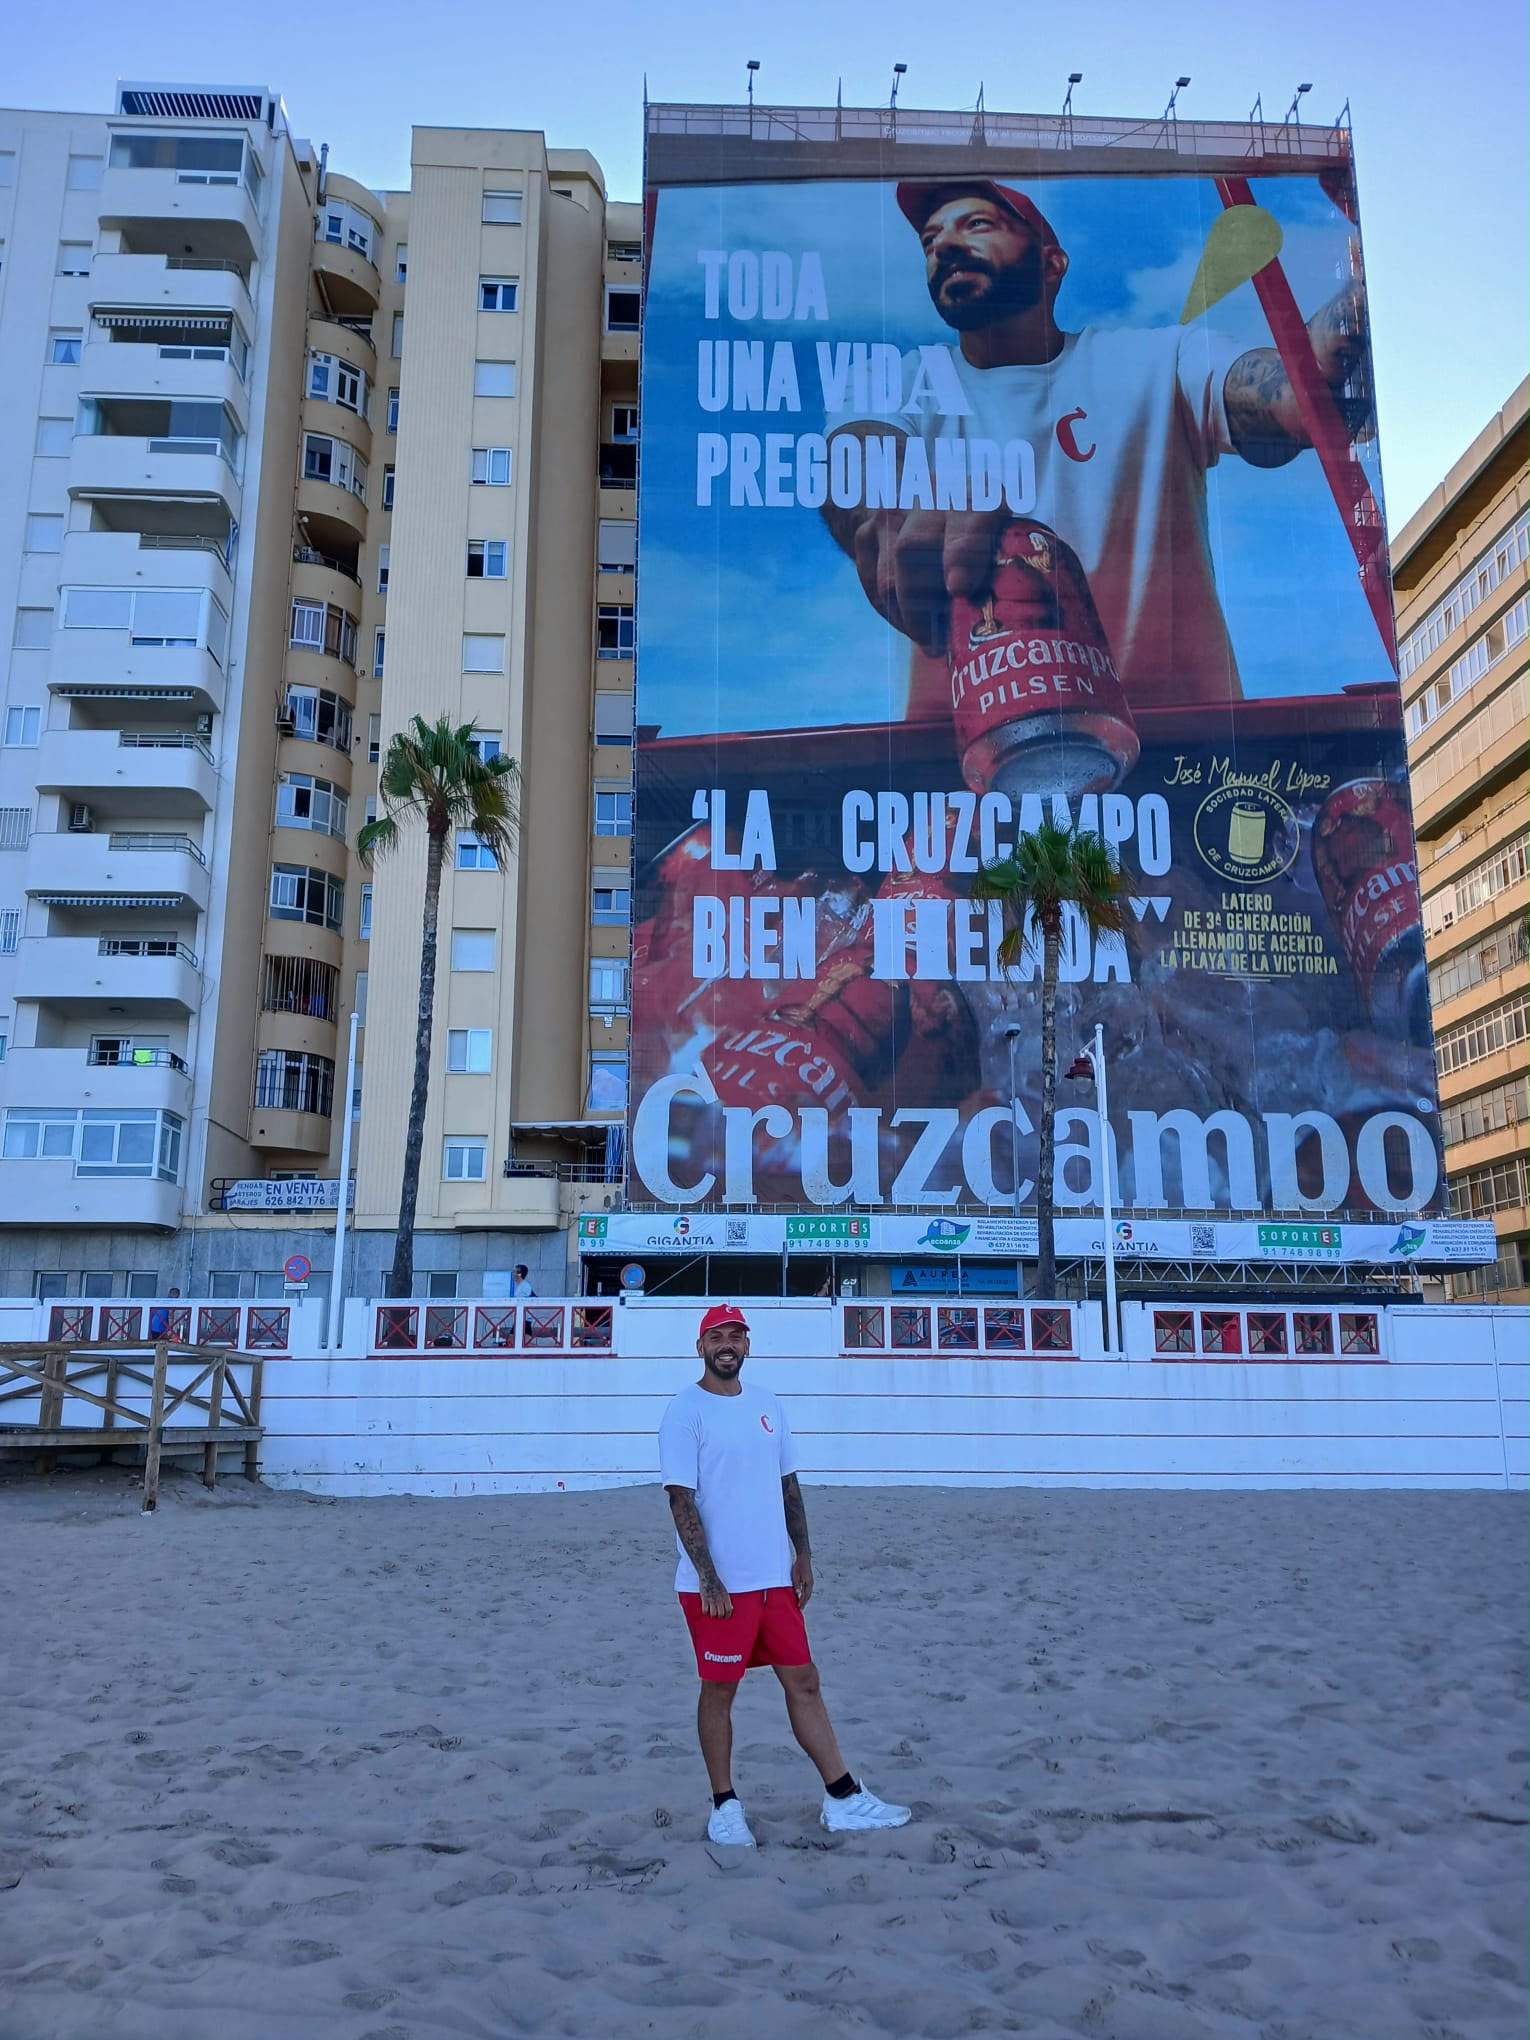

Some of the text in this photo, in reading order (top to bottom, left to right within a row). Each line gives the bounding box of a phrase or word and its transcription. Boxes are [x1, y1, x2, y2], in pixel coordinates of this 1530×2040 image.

[698, 250, 829, 320] TODA
[698, 340, 974, 416] UNA VIDA
[696, 432, 1036, 513] PREGONANDO
[979, 674, 1094, 715] PILSEN
[1163, 755, 1331, 798] José Manuel López
[1206, 788, 1289, 823] SOCIEDAD LATERA
[1208, 848, 1284, 877] DE CRUZCAMPO
[1222, 892, 1272, 912] LATERO
[1184, 911, 1201, 928] DE
[1227, 911, 1311, 933] GENERACIÓN
[693, 895, 816, 979] BIEN
[1174, 930, 1322, 953] LLENANDO DE ACENTO
[1160, 950, 1338, 974] LA PLAYA DE LA VICTORIA
[633, 1062, 1438, 1212] Cruzcampo
[266, 1183, 282, 1195] EN
[285, 1182, 325, 1194] VENTA
[265, 1196, 325, 1206] 626 842 176
[788, 1221, 868, 1234] SOPORTES
[1260, 1230, 1340, 1243] SOPORTES
[591, 1239, 605, 1248] 99
[647, 1236, 714, 1245] GIGANTIA
[808, 1240, 830, 1248] 748
[855, 1240, 868, 1248] 99
[1262, 1247, 1340, 1257] 91 748 98 99
[704, 1651, 742, 1664] Cruzcampo
